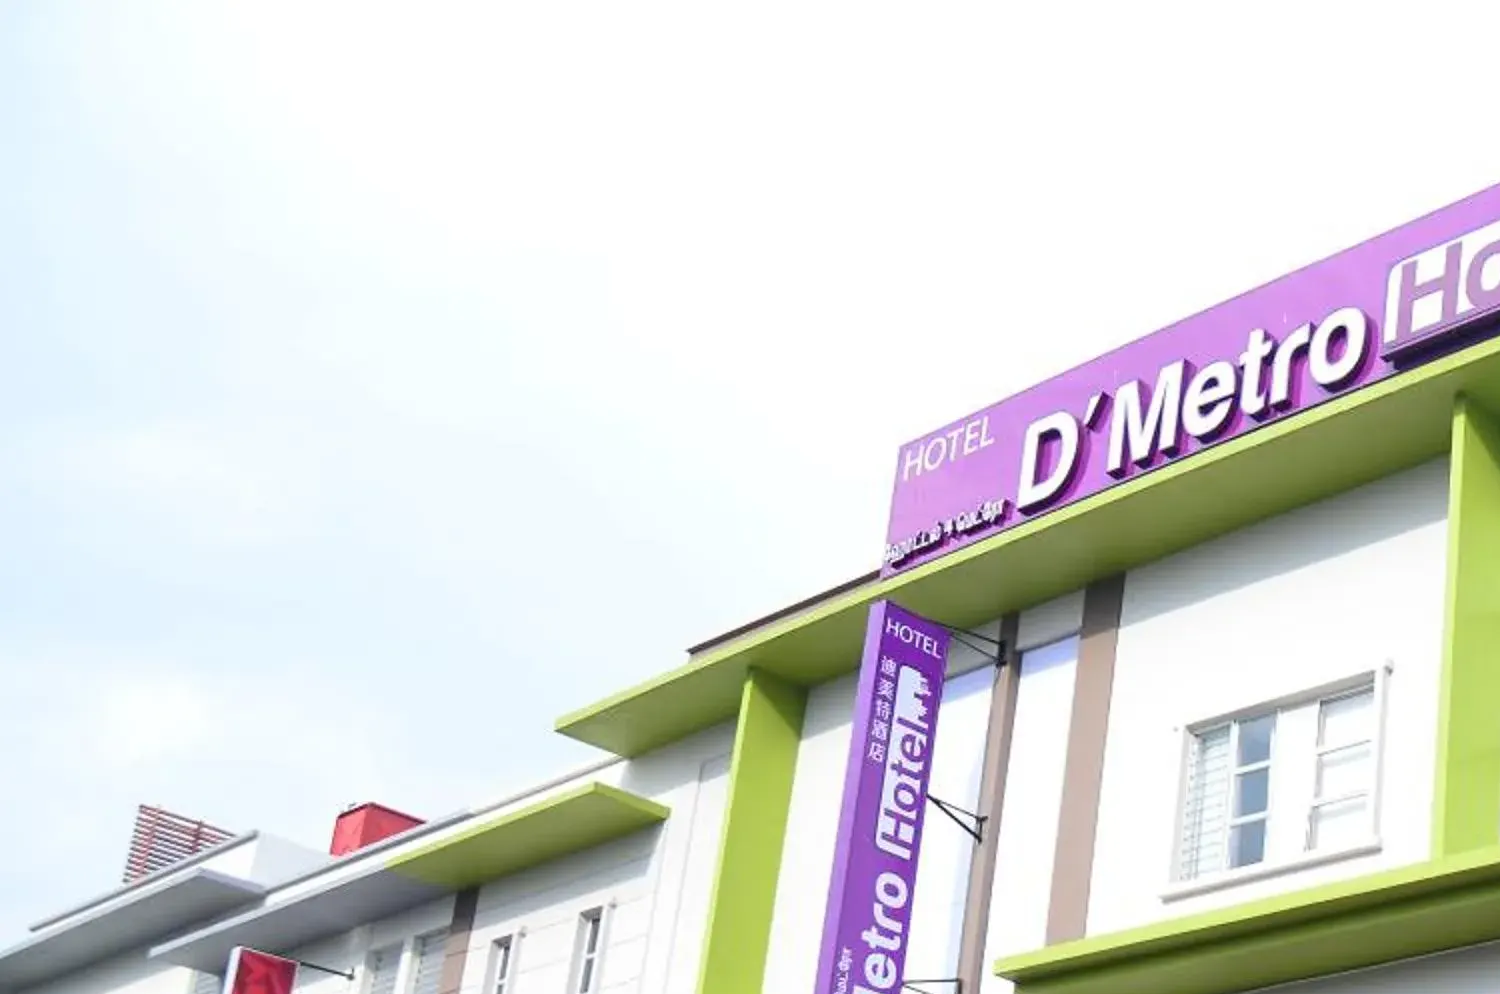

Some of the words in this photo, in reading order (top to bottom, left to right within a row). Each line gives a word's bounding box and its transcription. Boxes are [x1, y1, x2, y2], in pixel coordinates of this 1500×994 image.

[902, 416, 995, 482] HOTEL
[885, 617, 942, 659] HOTEL
[880, 716, 929, 850] Hotel
